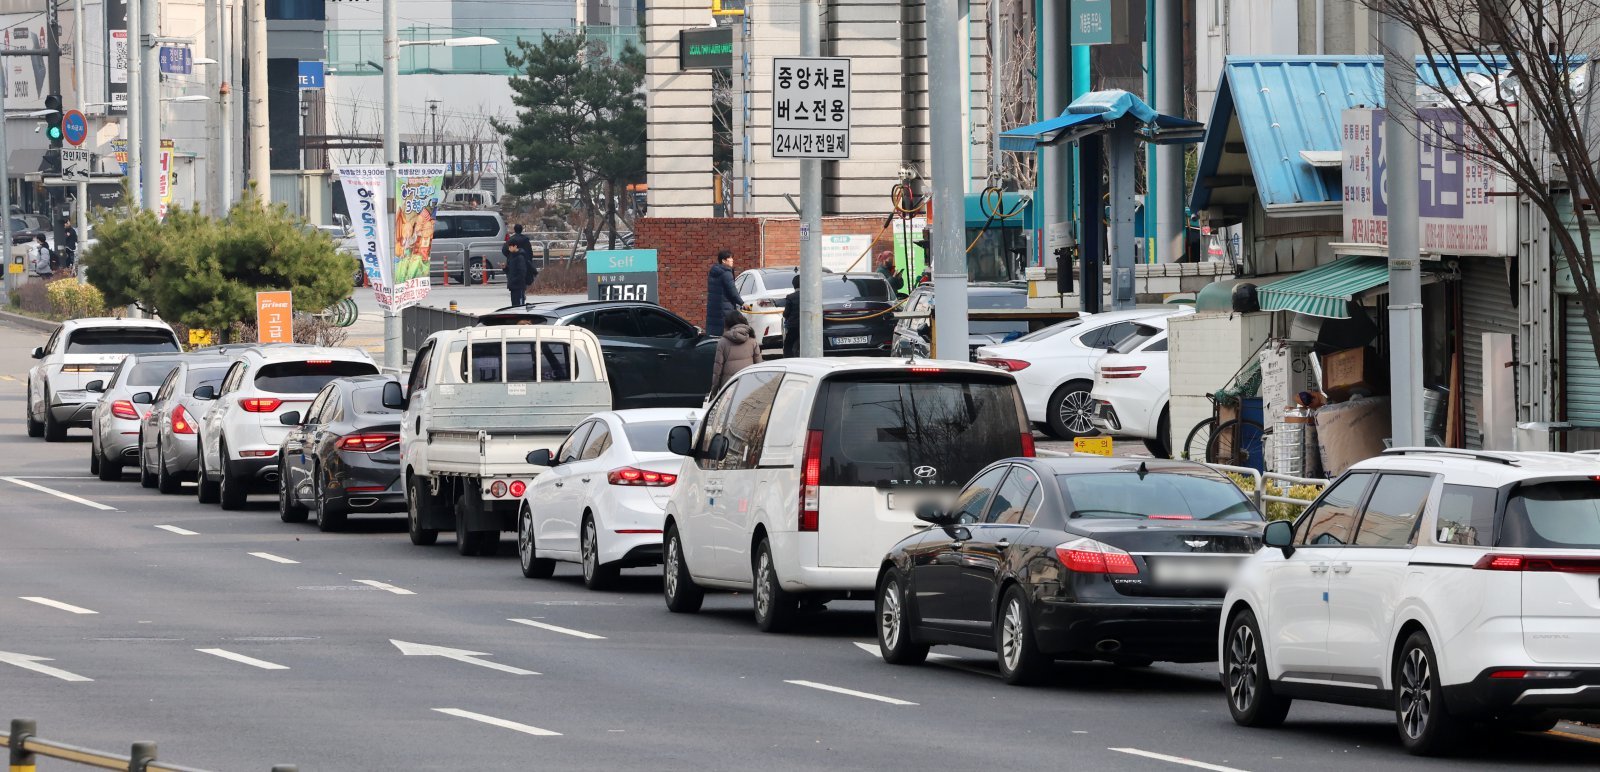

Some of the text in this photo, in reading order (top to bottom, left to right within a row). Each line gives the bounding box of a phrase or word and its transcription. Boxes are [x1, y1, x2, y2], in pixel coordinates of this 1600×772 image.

[169, 48, 183, 62] 경인로
[310, 75, 315, 85] 1
[778, 66, 846, 90] 중앙차로
[777, 98, 845, 122] 버스전용
[66, 124, 84, 132] 주차금지
[776, 133, 846, 153] 24시간 전일제
[62, 150, 88, 163] 견인지역
[398, 168, 421, 176] 특별할인
[1351, 218, 1388, 245] 제작시공전문
[609, 255, 635, 269] Self
[606, 284, 648, 301] 1760
[261, 302, 288, 310] prime
[268, 313, 283, 343] 고급
